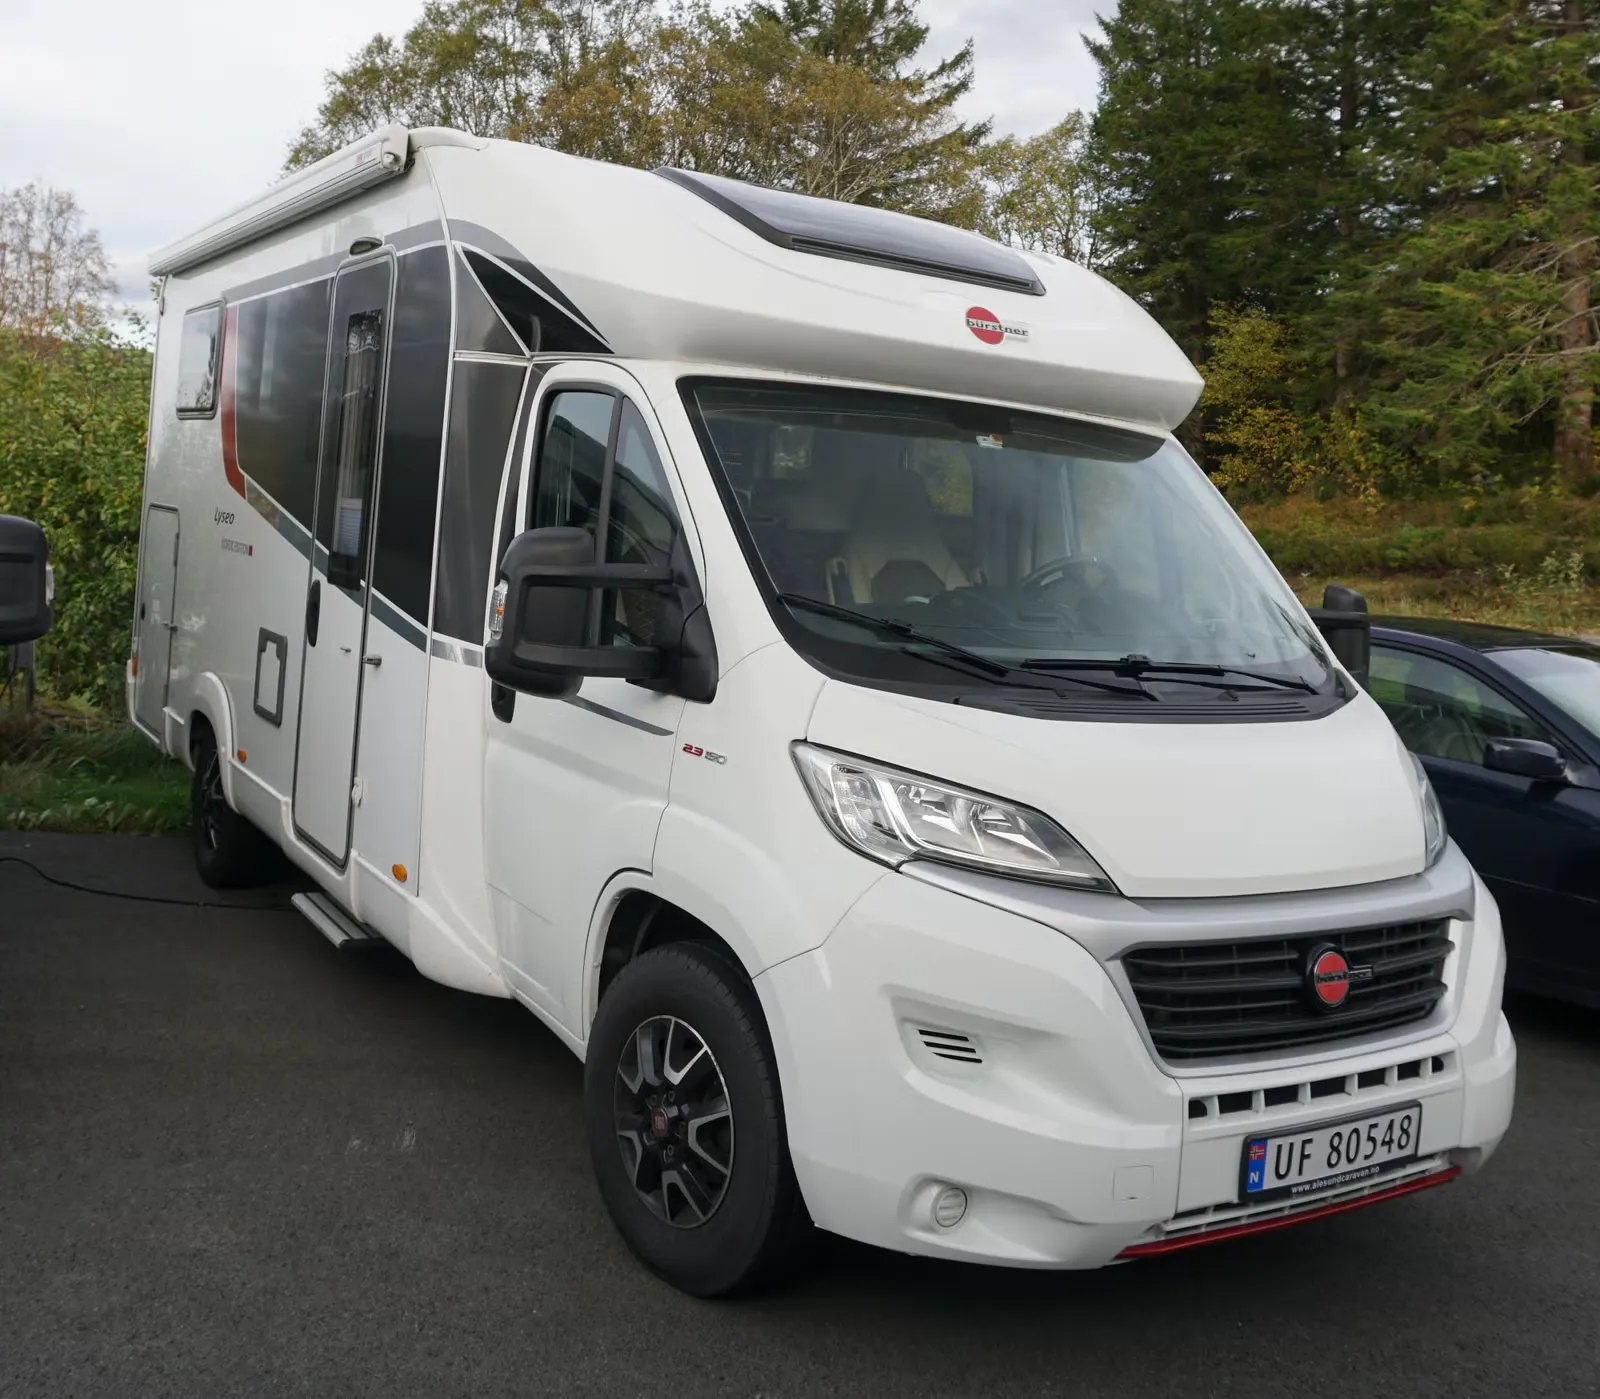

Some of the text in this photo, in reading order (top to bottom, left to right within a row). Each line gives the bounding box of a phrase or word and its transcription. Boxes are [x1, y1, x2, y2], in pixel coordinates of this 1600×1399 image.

[965, 318, 1029, 336] bürstner
[213, 506, 235, 525] Lyseo
[1274, 1114, 1413, 1180] UF 80548
[1249, 1171, 1260, 1184] N
[1291, 1165, 1380, 1194] www.alesundcaravan.no
